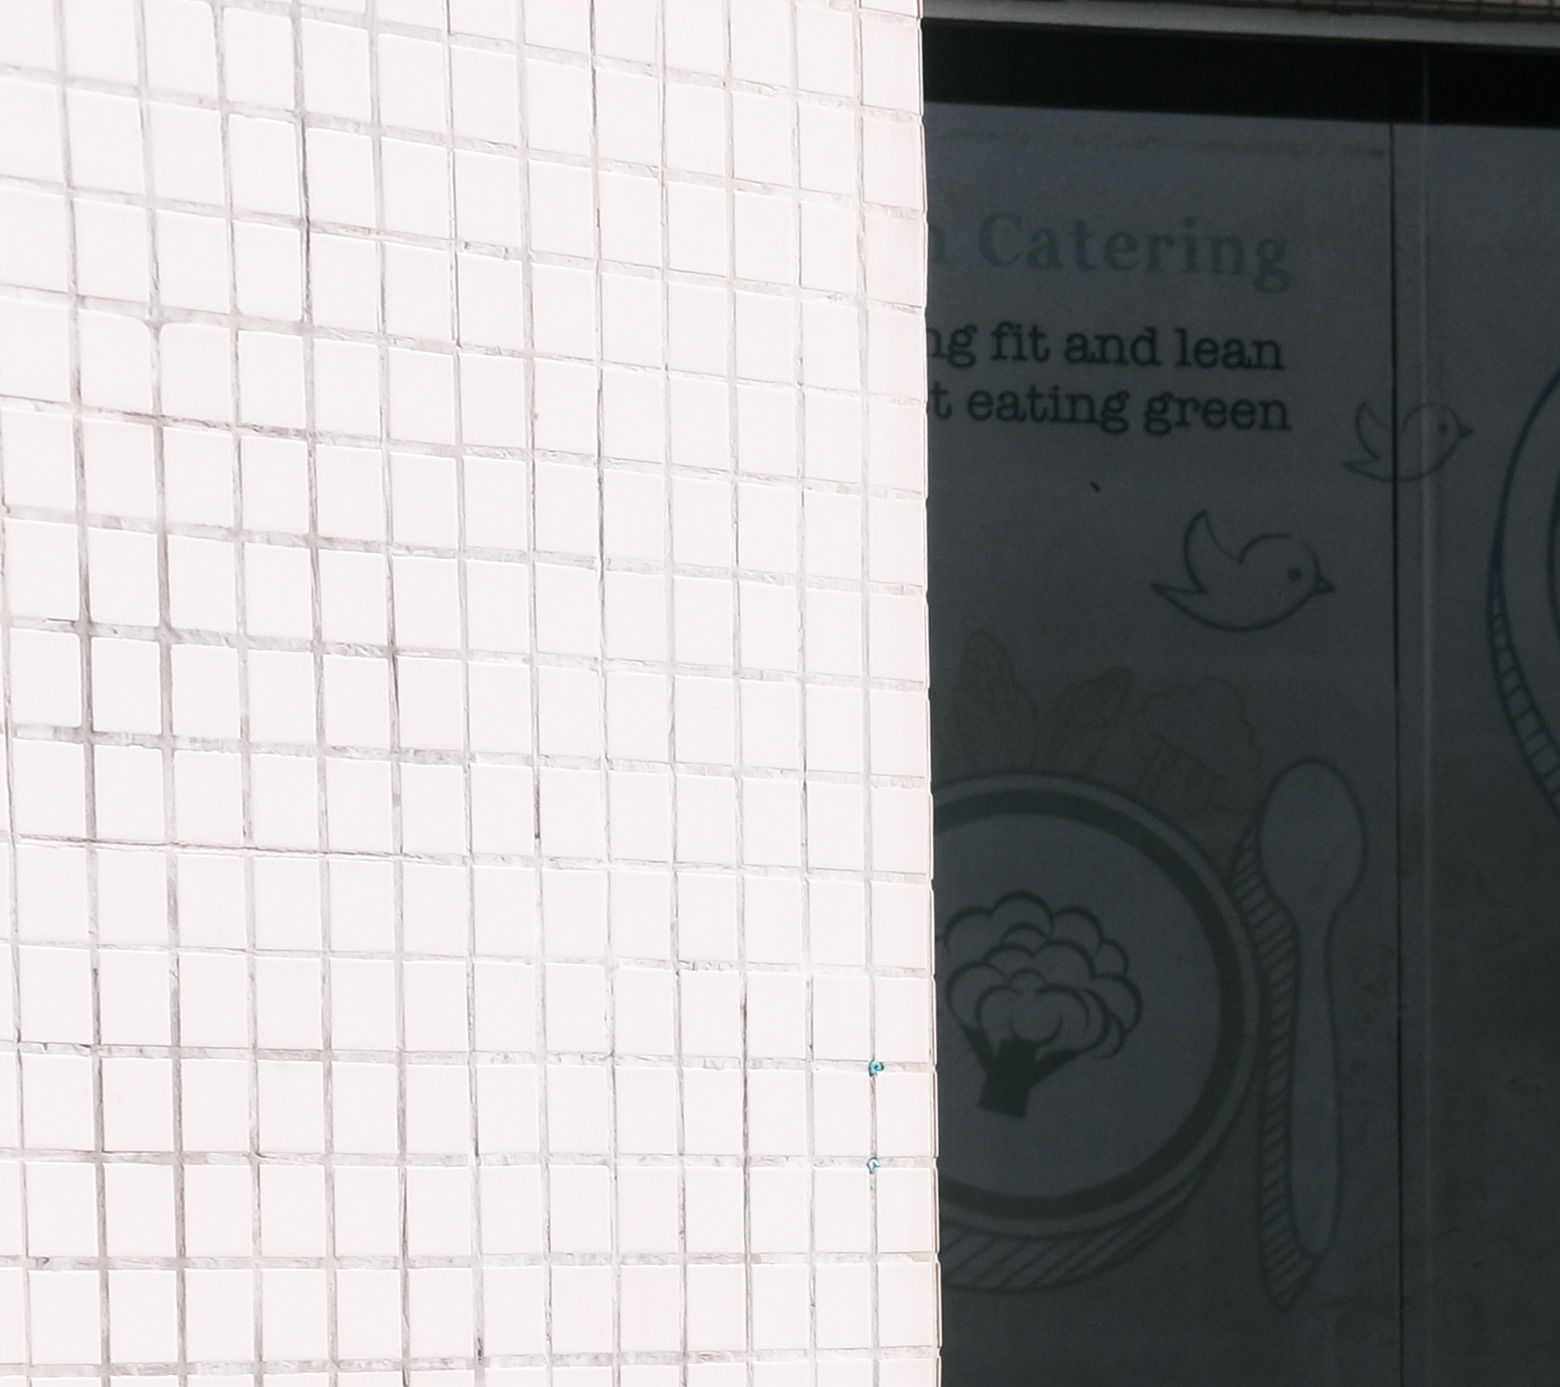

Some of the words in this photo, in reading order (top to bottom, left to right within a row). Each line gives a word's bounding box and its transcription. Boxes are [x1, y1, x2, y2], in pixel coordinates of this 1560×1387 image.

[978, 212, 1292, 295] Catering
[990, 320, 1050, 363] fit
[1063, 326, 1163, 368] and
[1174, 327, 1287, 371] lean
[966, 383, 1130, 435] eating
[1143, 391, 1292, 437] green
